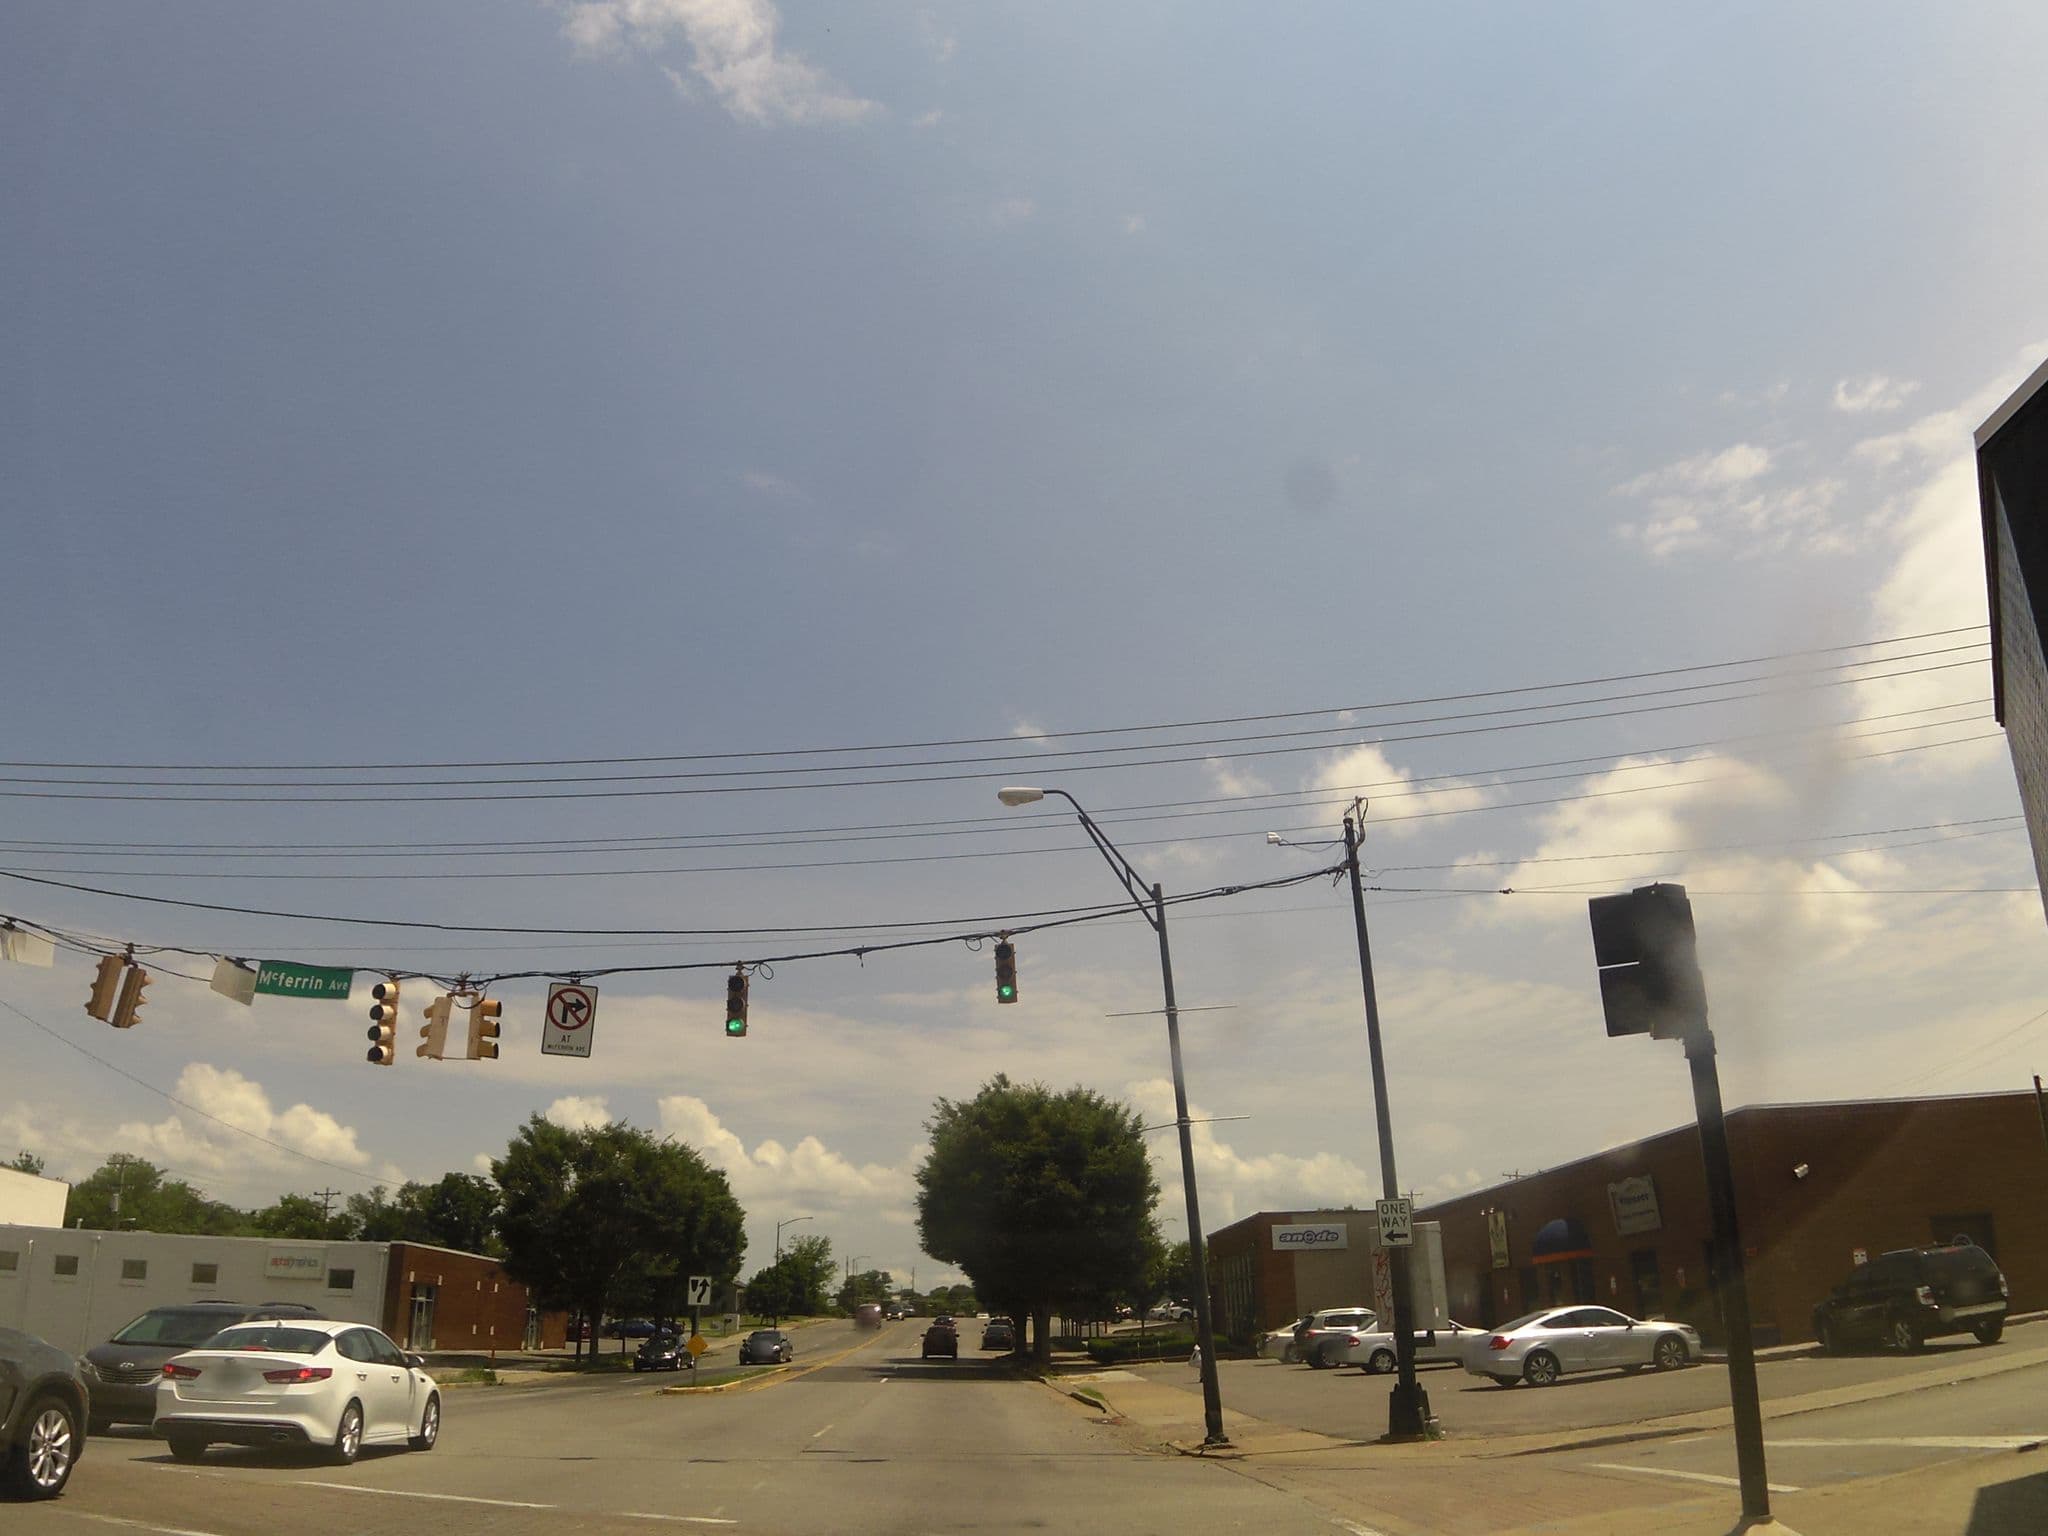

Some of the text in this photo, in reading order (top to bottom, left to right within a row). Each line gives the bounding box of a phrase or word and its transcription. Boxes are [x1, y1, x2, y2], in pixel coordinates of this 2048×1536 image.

[328, 979, 349, 990] Ave
[560, 1034, 571, 1043] AT
[1381, 1202, 1406, 1215] ONE
[1381, 1215, 1408, 1228] WAY
